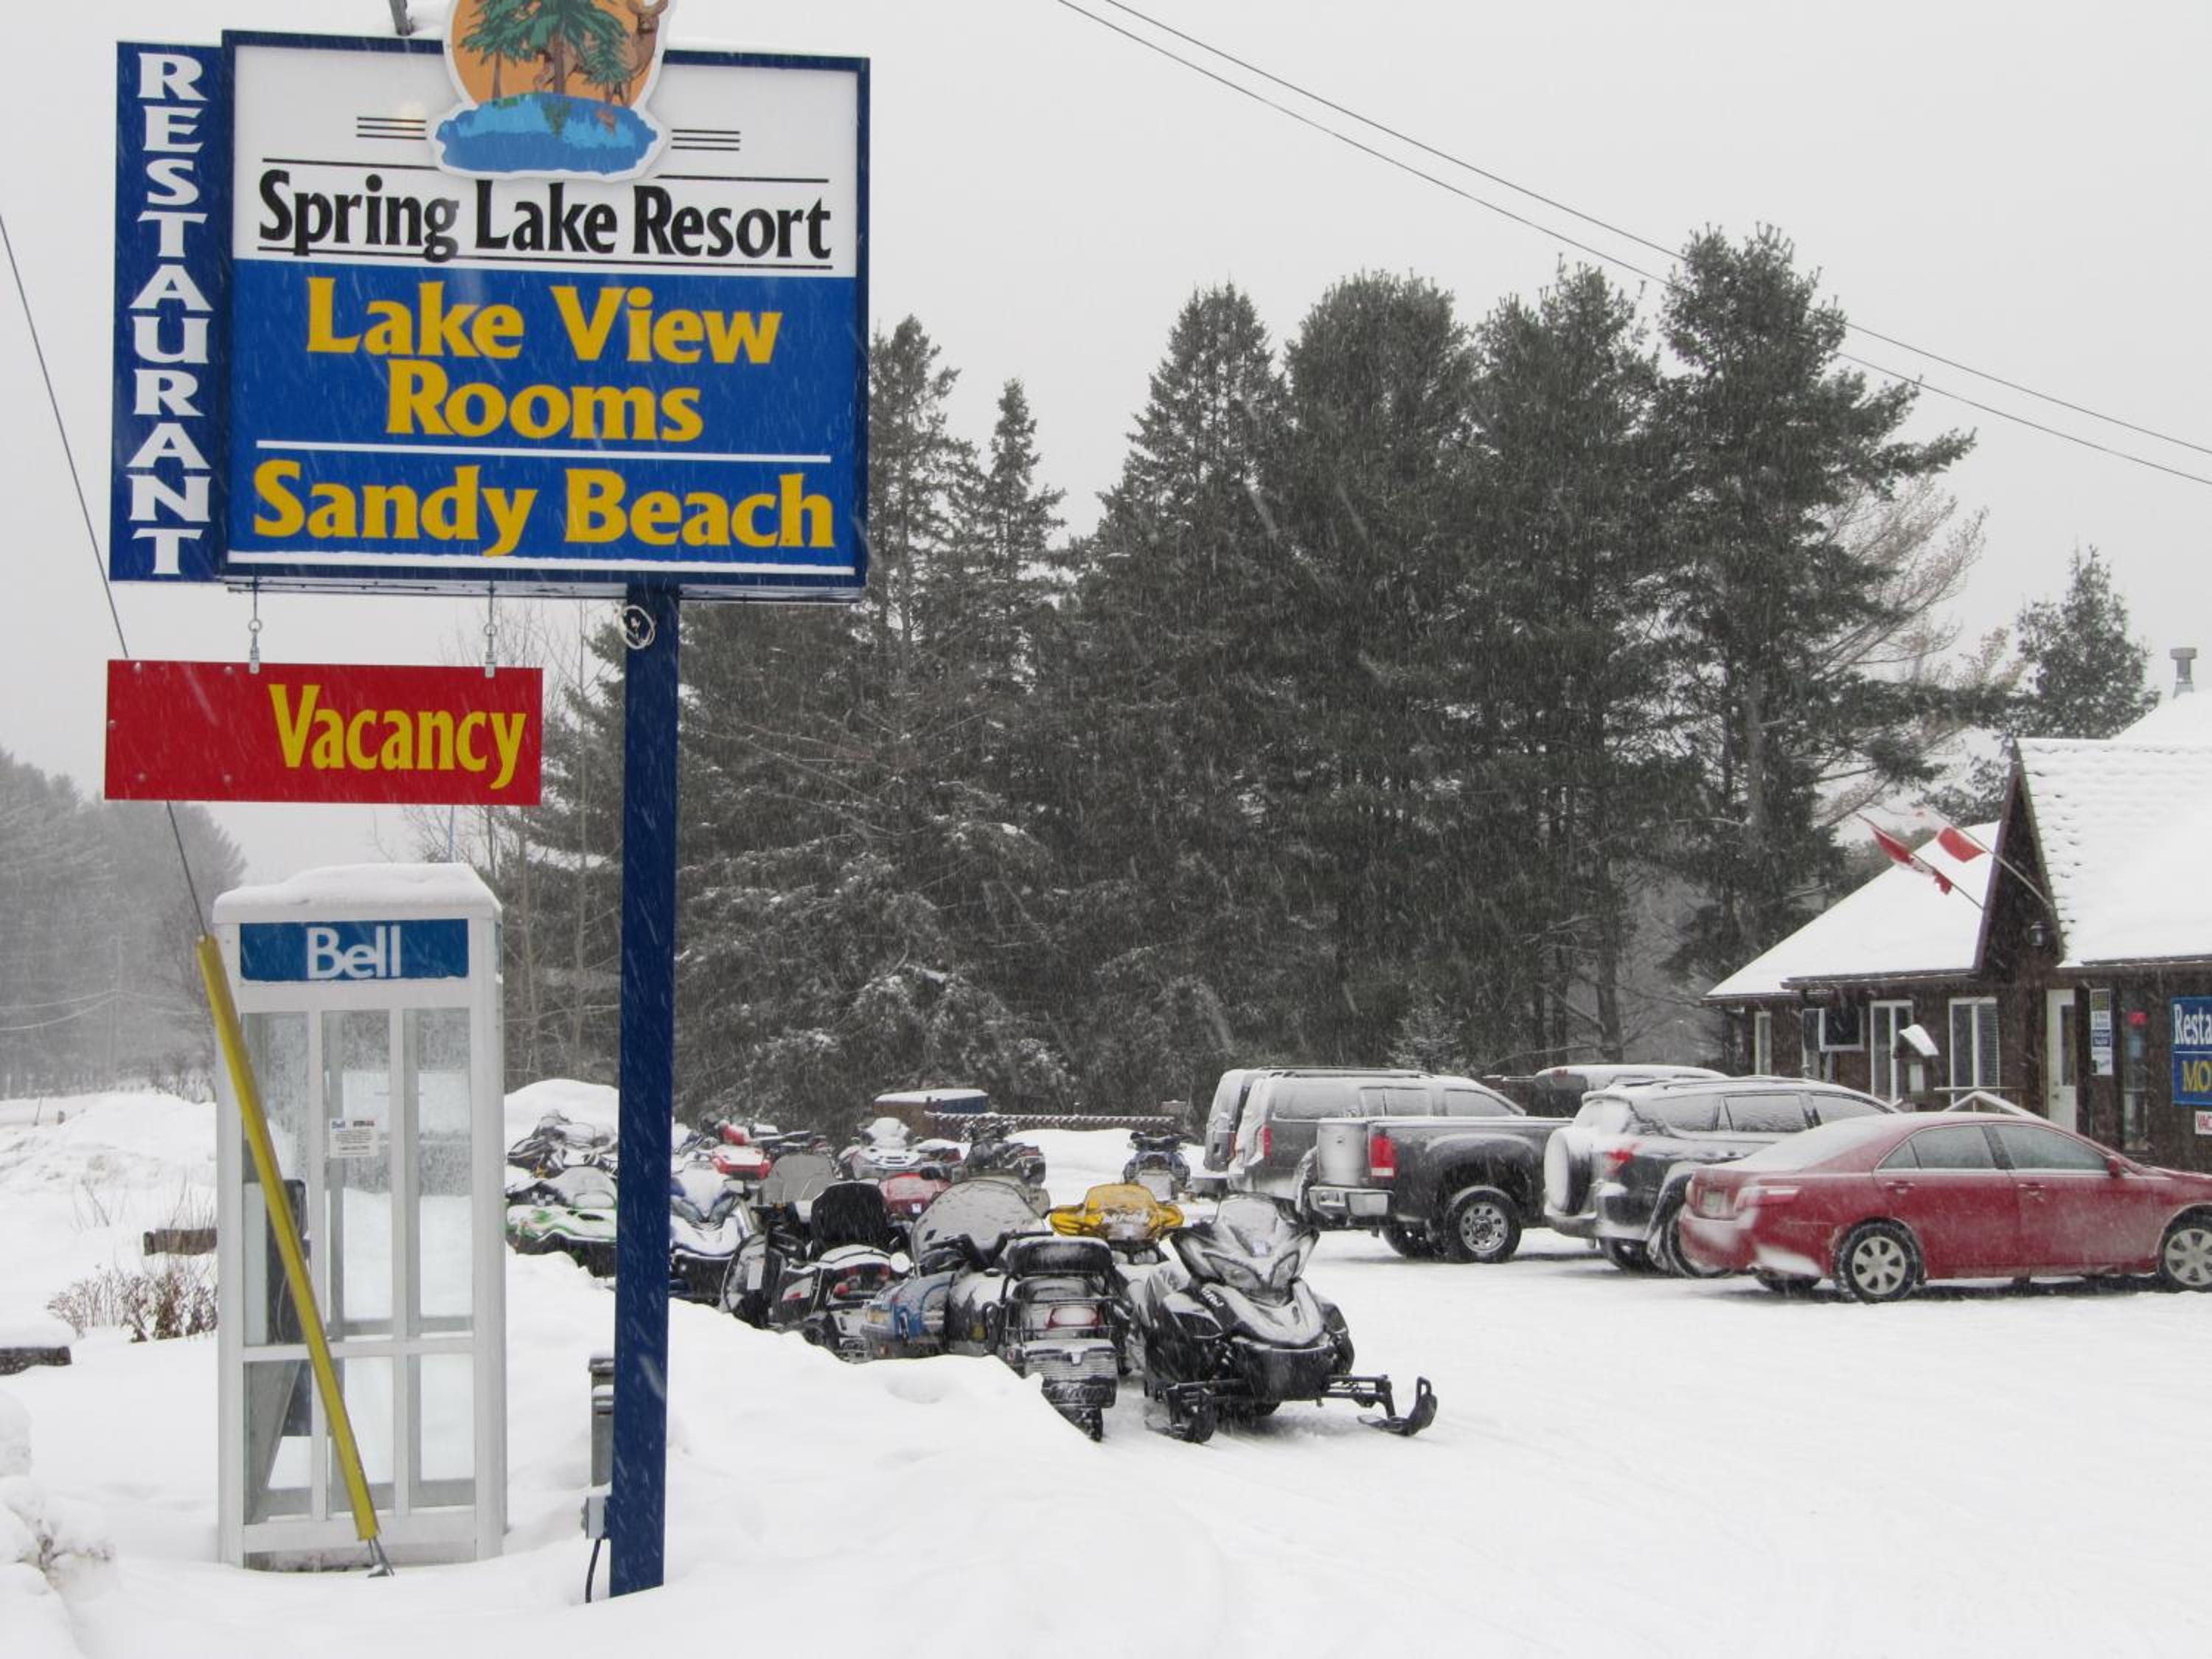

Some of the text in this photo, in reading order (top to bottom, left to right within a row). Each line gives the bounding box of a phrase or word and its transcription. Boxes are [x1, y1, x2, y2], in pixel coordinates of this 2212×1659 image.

[259, 169, 832, 263] Spring Lake Resort
[127, 52, 213, 575] RESTAURANT
[306, 276, 783, 364] Lake View
[386, 358, 704, 442] Rooms
[252, 459, 835, 558] Sandy Beach
[268, 683, 527, 791] Vacancy
[306, 925, 402, 980] Bell
